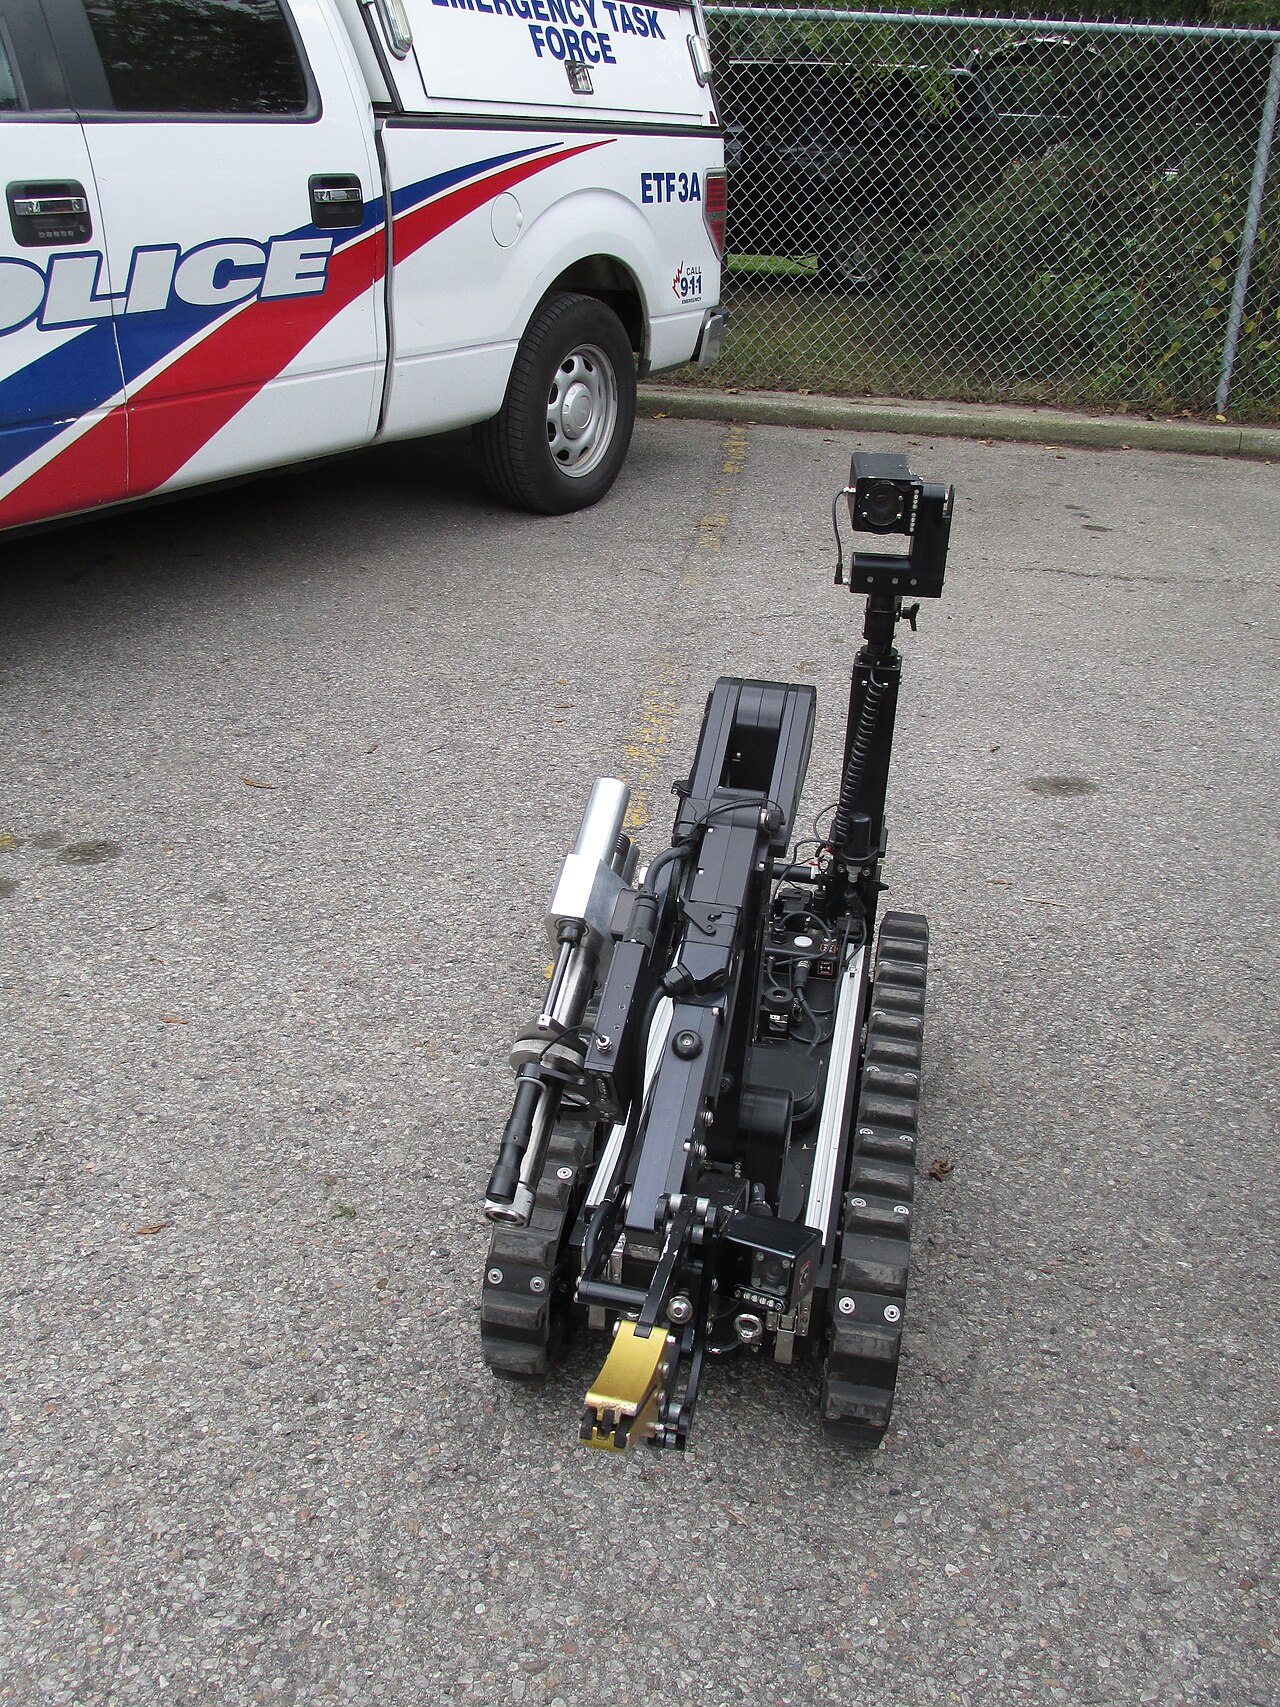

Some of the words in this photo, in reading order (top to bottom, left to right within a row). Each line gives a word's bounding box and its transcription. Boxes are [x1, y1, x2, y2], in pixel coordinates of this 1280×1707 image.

[431, 0, 598, 28] RGENCY
[604, 3, 666, 40] TASK
[528, 24, 617, 64] FORCE
[686, 266, 702, 276] CALL
